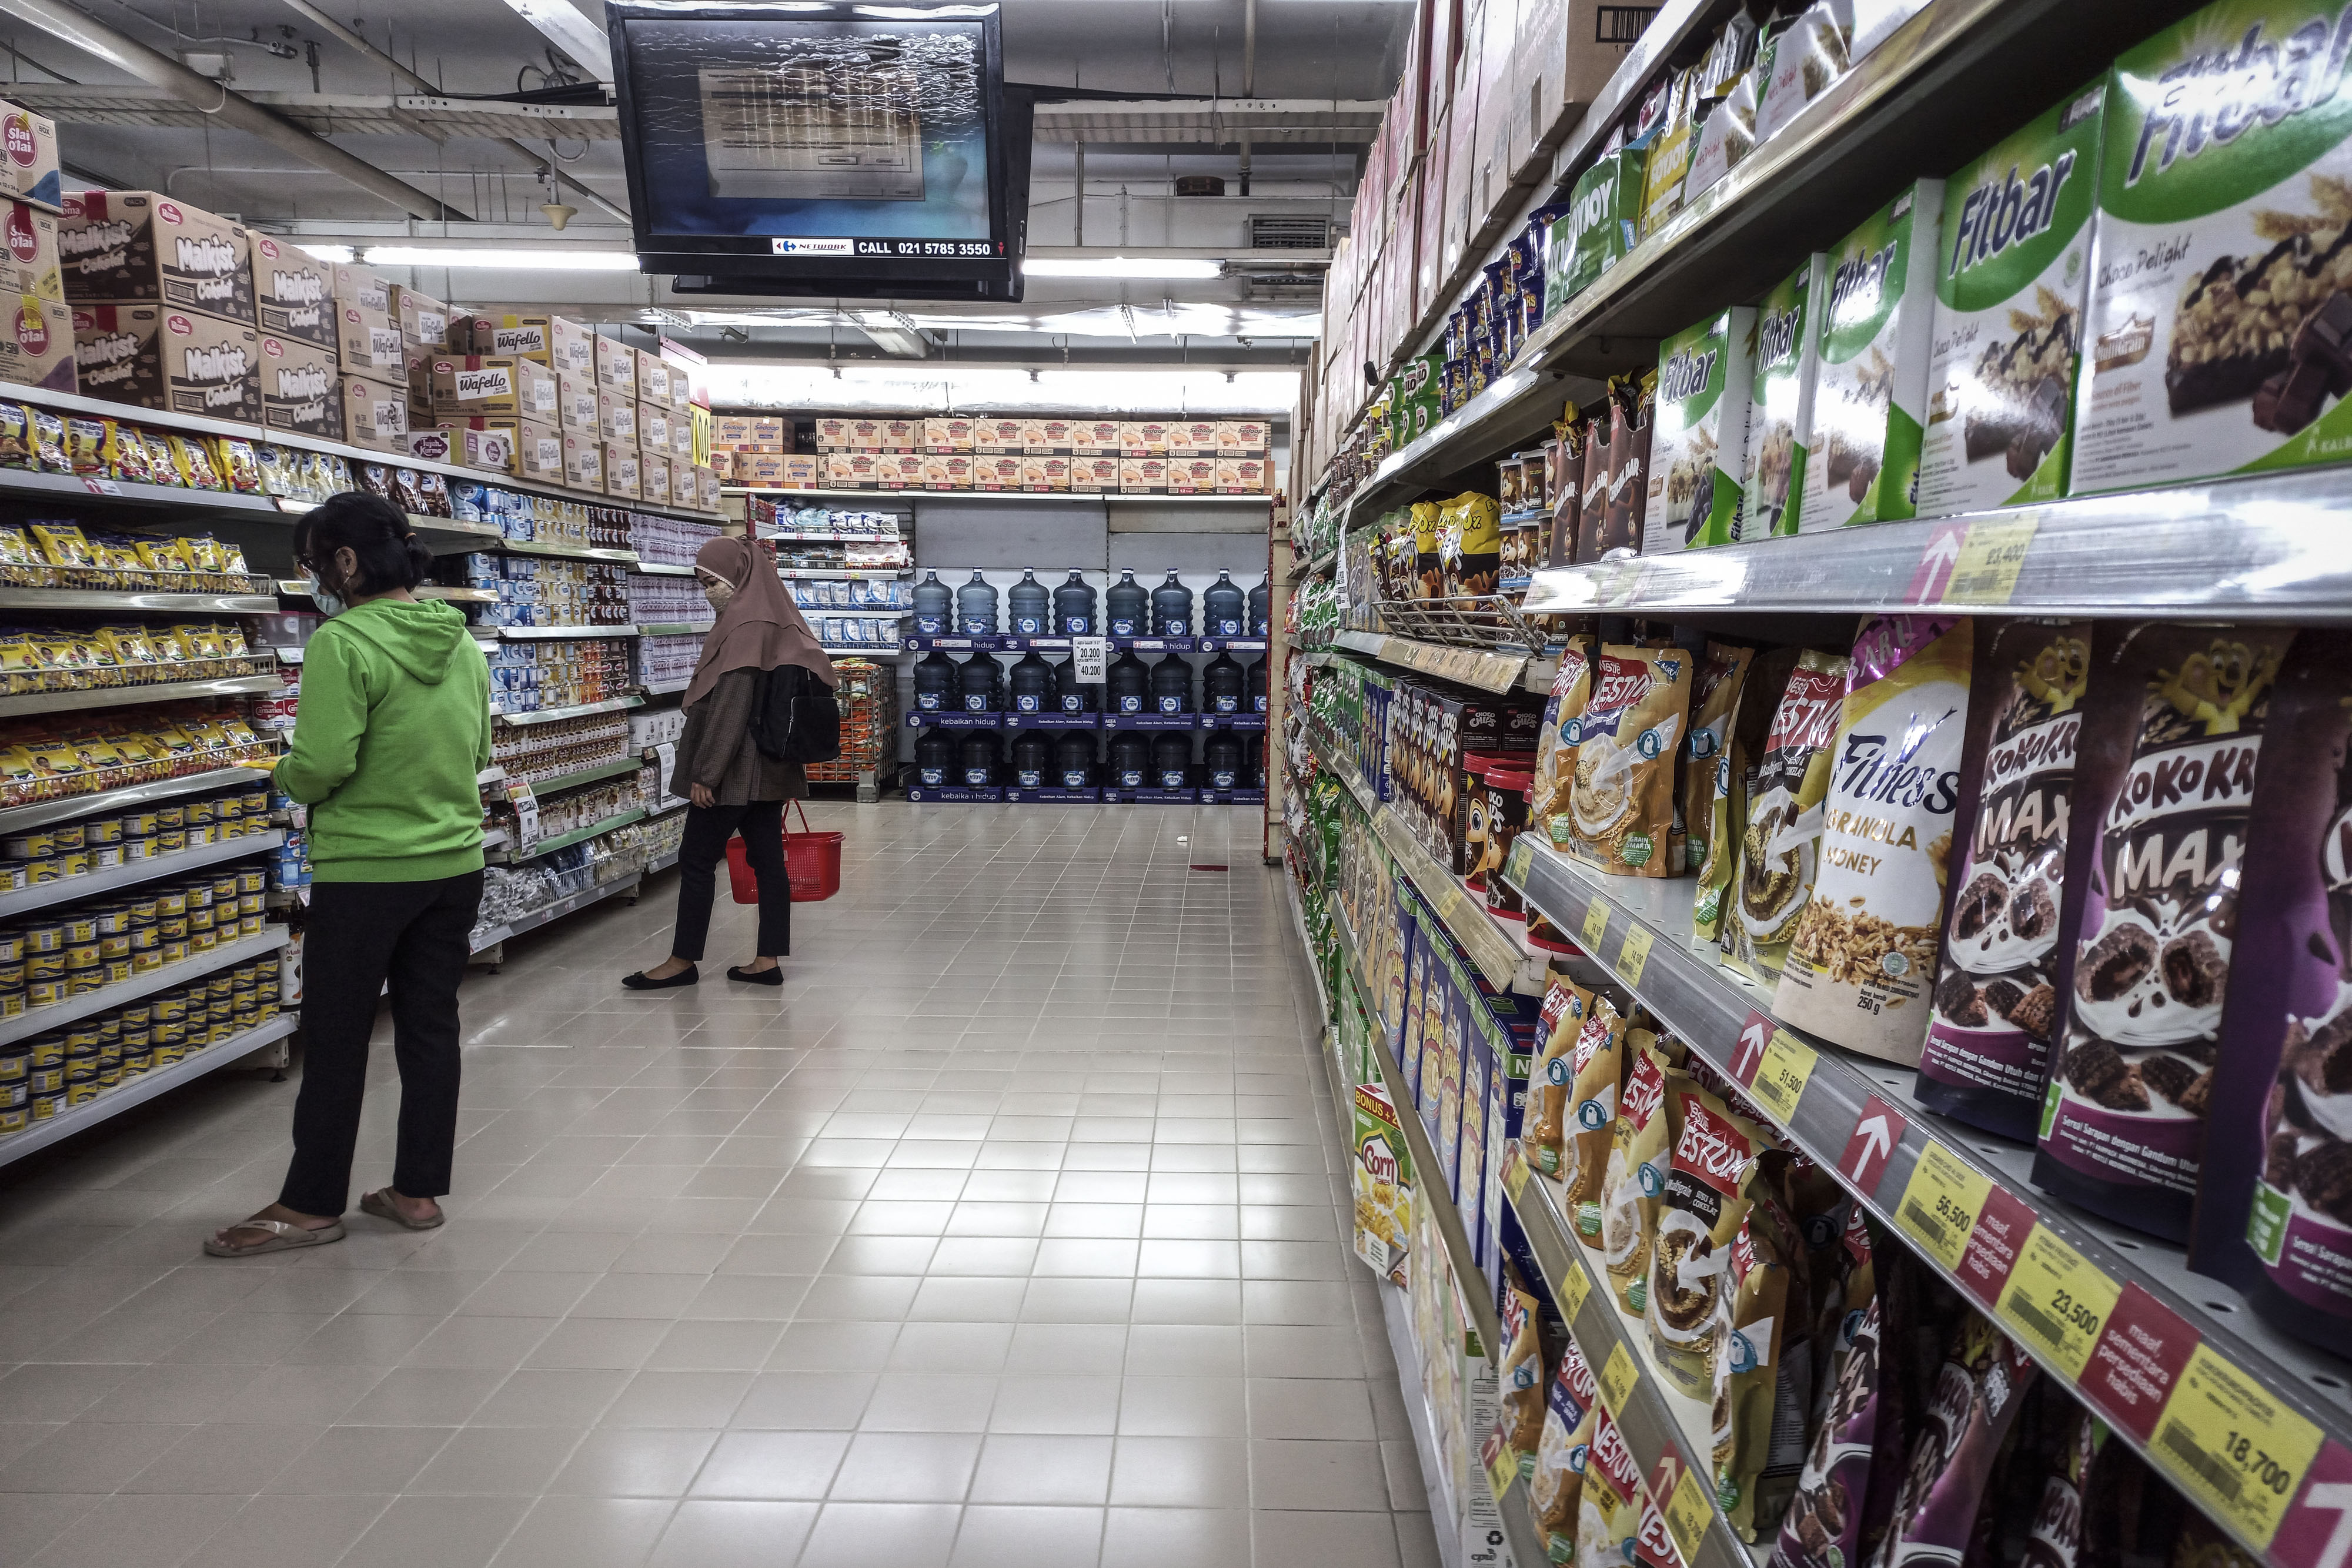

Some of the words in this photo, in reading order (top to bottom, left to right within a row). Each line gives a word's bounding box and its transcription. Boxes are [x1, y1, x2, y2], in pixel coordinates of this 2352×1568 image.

[8, 128, 30, 140] Slai
[38, 125, 51, 136] BOX
[1651, 139, 1690, 189] SOYJOY
[40, 220, 51, 230] BOX
[162, 208, 181, 222] Roma
[1949, 148, 2077, 281] Fitbar
[1626, 223, 1636, 247] SOYJOY
[176, 233, 236, 278] Malkist
[858, 242, 891, 254] CALL
[898, 242, 920, 255] 021
[924, 243, 955, 255] 5785
[2099, 262, 2136, 289] Choco
[2138, 233, 2192, 276] Delight
[196, 279, 234, 300] Cokelat
[272, 266, 323, 307] Malkist
[1823, 239, 1897, 337] Fitbar
[52, 307, 65, 317] BOX
[420, 320, 444, 340] Wafello
[497, 330, 540, 351] Wafello
[1755, 304, 1800, 379] Fitbar
[372, 336, 402, 360] Wafello
[185, 340, 247, 383] Malkist
[277, 362, 328, 401] Malkist
[459, 373, 506, 394] Wafello
[1662, 346, 1717, 406] Fitbar
[206, 383, 244, 408] Cokelat
[974, 641, 995, 650] hidup
[1080, 648, 1100, 658] 20.200
[1849, 613, 1913, 681] BARU
[1081, 666, 1101, 676] 40.200
[255, 706, 283, 717] Carnation
[975, 718, 996, 726] hidup
[1441, 713, 1458, 734] CHOCO
[1469, 717, 1497, 728] CHIPS
[1511, 718, 1538, 729] CHIPS
[1436, 727, 1458, 767] CHIPS
[1832, 732, 1960, 814] Fitness
[1826, 808, 1918, 851] GRANOLA
[1977, 788, 2071, 855] MAX
[1625, 842, 1652, 850] SMARTA
[1824, 845, 1882, 877] HONEY
[2114, 828, 2246, 900] MAX
[1592, 923, 1602, 937] 14,100
[1631, 950, 1643, 965] 14,100
[1857, 996, 1873, 1011] 250
[1873, 1002, 1881, 1015] g
[1860, 988, 1872, 998] Berat
[1929, 1035, 1941, 1047] Sereal
[1940, 1039, 1959, 1054] Sarapan
[1959, 1048, 1979, 1061] dengan
[1978, 1054, 2004, 1071] Gandum
[1779, 1068, 1802, 1094] 51,500
[1355, 1090, 1384, 1116] BONUS
[2062, 1115, 2083, 1131] Sereal
[2083, 1123, 2110, 1142] Sarapan
[2110, 1135, 2140, 1154] dengan
[2141, 1145, 2177, 1166] Gandum
[1364, 1144, 1395, 1185] Corn
[1692, 1199, 1719, 1216] COKELAT
[1936, 1195, 1971, 1232] 56,500
[1985, 1214, 2011, 1240] maaf,
[1972, 1224, 2013, 1260] ementara
[2293, 1235, 2316, 1255] Sereal
[1968, 1238, 2008, 1275] ersediaan
[1968, 1253, 1991, 1280] habis
[2051, 1289, 2099, 1336] 23,500
[2127, 1324, 2163, 1359] maaf,
[2106, 1329, 2170, 1385] sementara
[2097, 1345, 2163, 1403] persediaan
[2106, 1369, 2138, 1406] habis
[1592, 1413, 1640, 1492] NESTUM
[2224, 1429, 2291, 1495] 18,700
